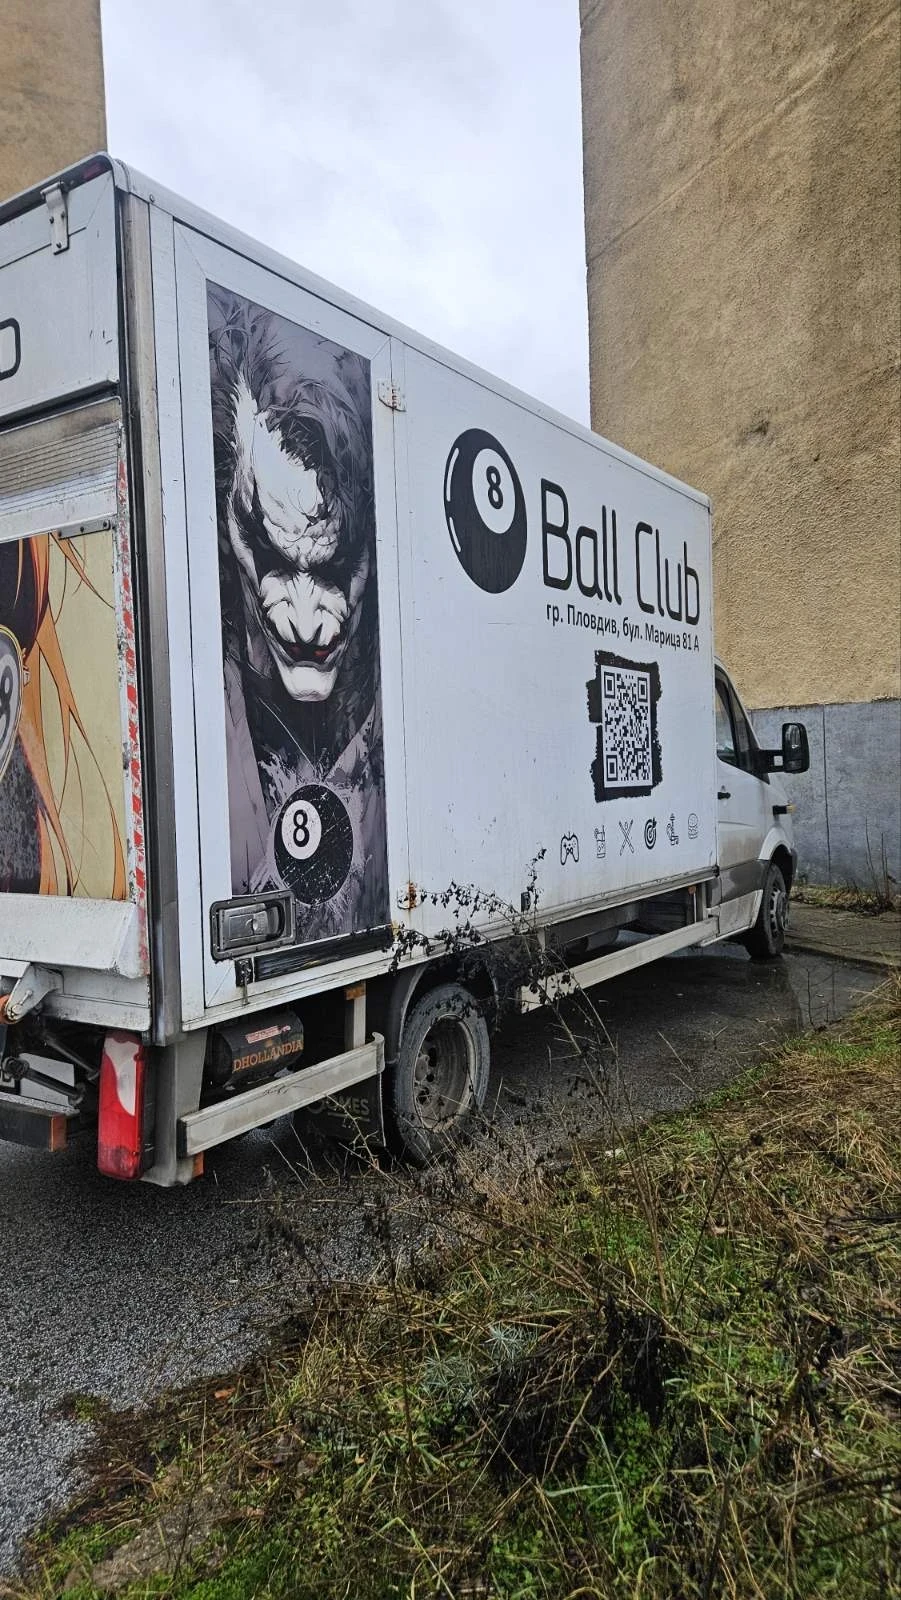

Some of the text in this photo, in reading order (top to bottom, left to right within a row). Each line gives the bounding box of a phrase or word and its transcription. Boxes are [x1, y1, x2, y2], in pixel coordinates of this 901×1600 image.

[486, 465, 700, 625] 8 Ball Club
[546, 604, 564, 627] гр.
[567, 604, 620, 638] Пловдив,
[622, 617, 643, 642] бул.
[645, 622, 681, 651] Марица
[682, 632, 692, 650] 81
[293, 809, 310, 847] 8
[233, 1039, 304, 1073] DHOLLANDIA
